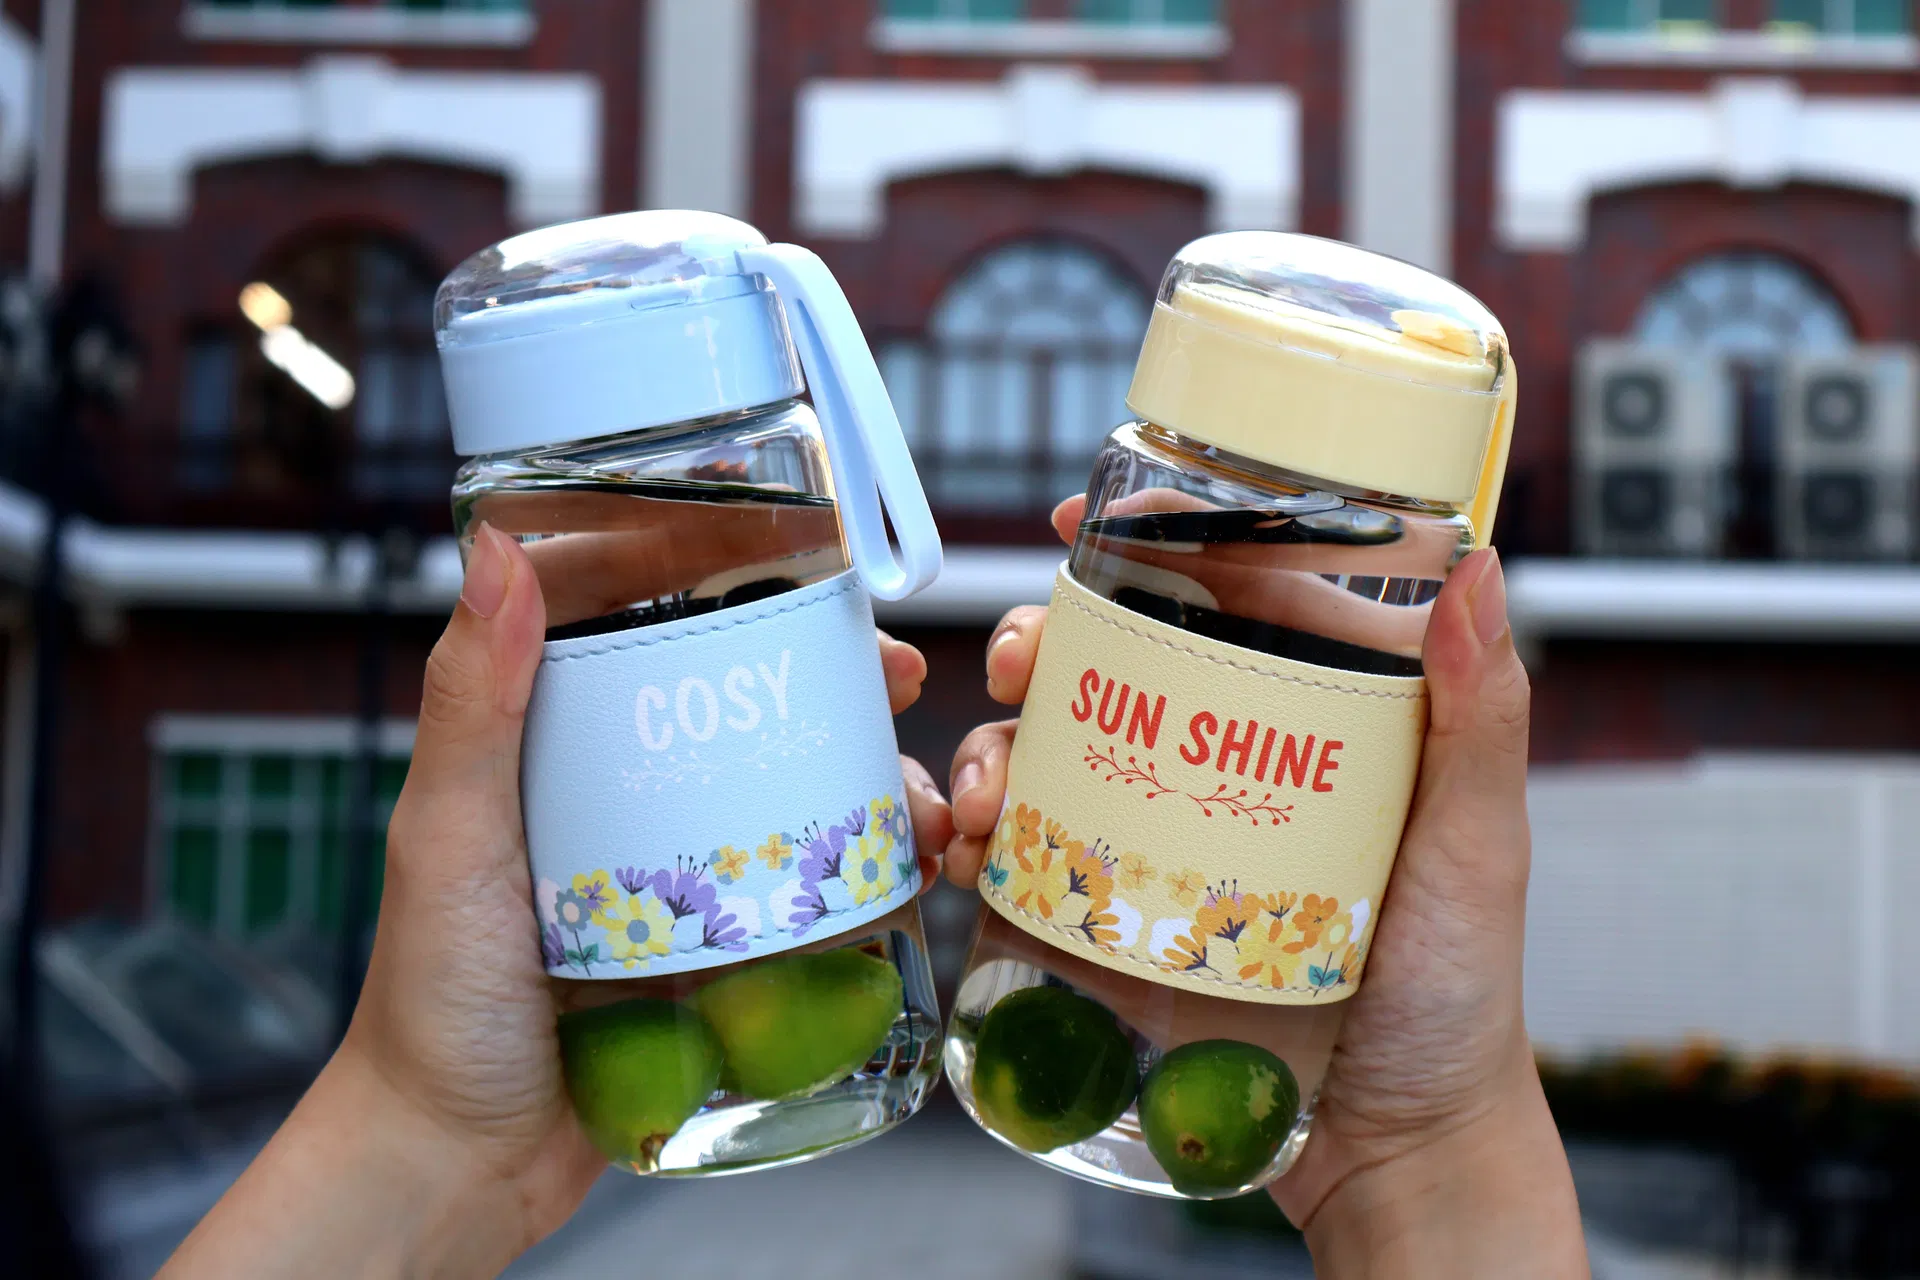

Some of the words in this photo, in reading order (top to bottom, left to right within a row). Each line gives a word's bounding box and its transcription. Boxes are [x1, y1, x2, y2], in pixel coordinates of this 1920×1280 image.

[635, 649, 791, 751] COSY
[1071, 668, 1167, 750] SUN
[1179, 711, 1344, 792] SHINE
